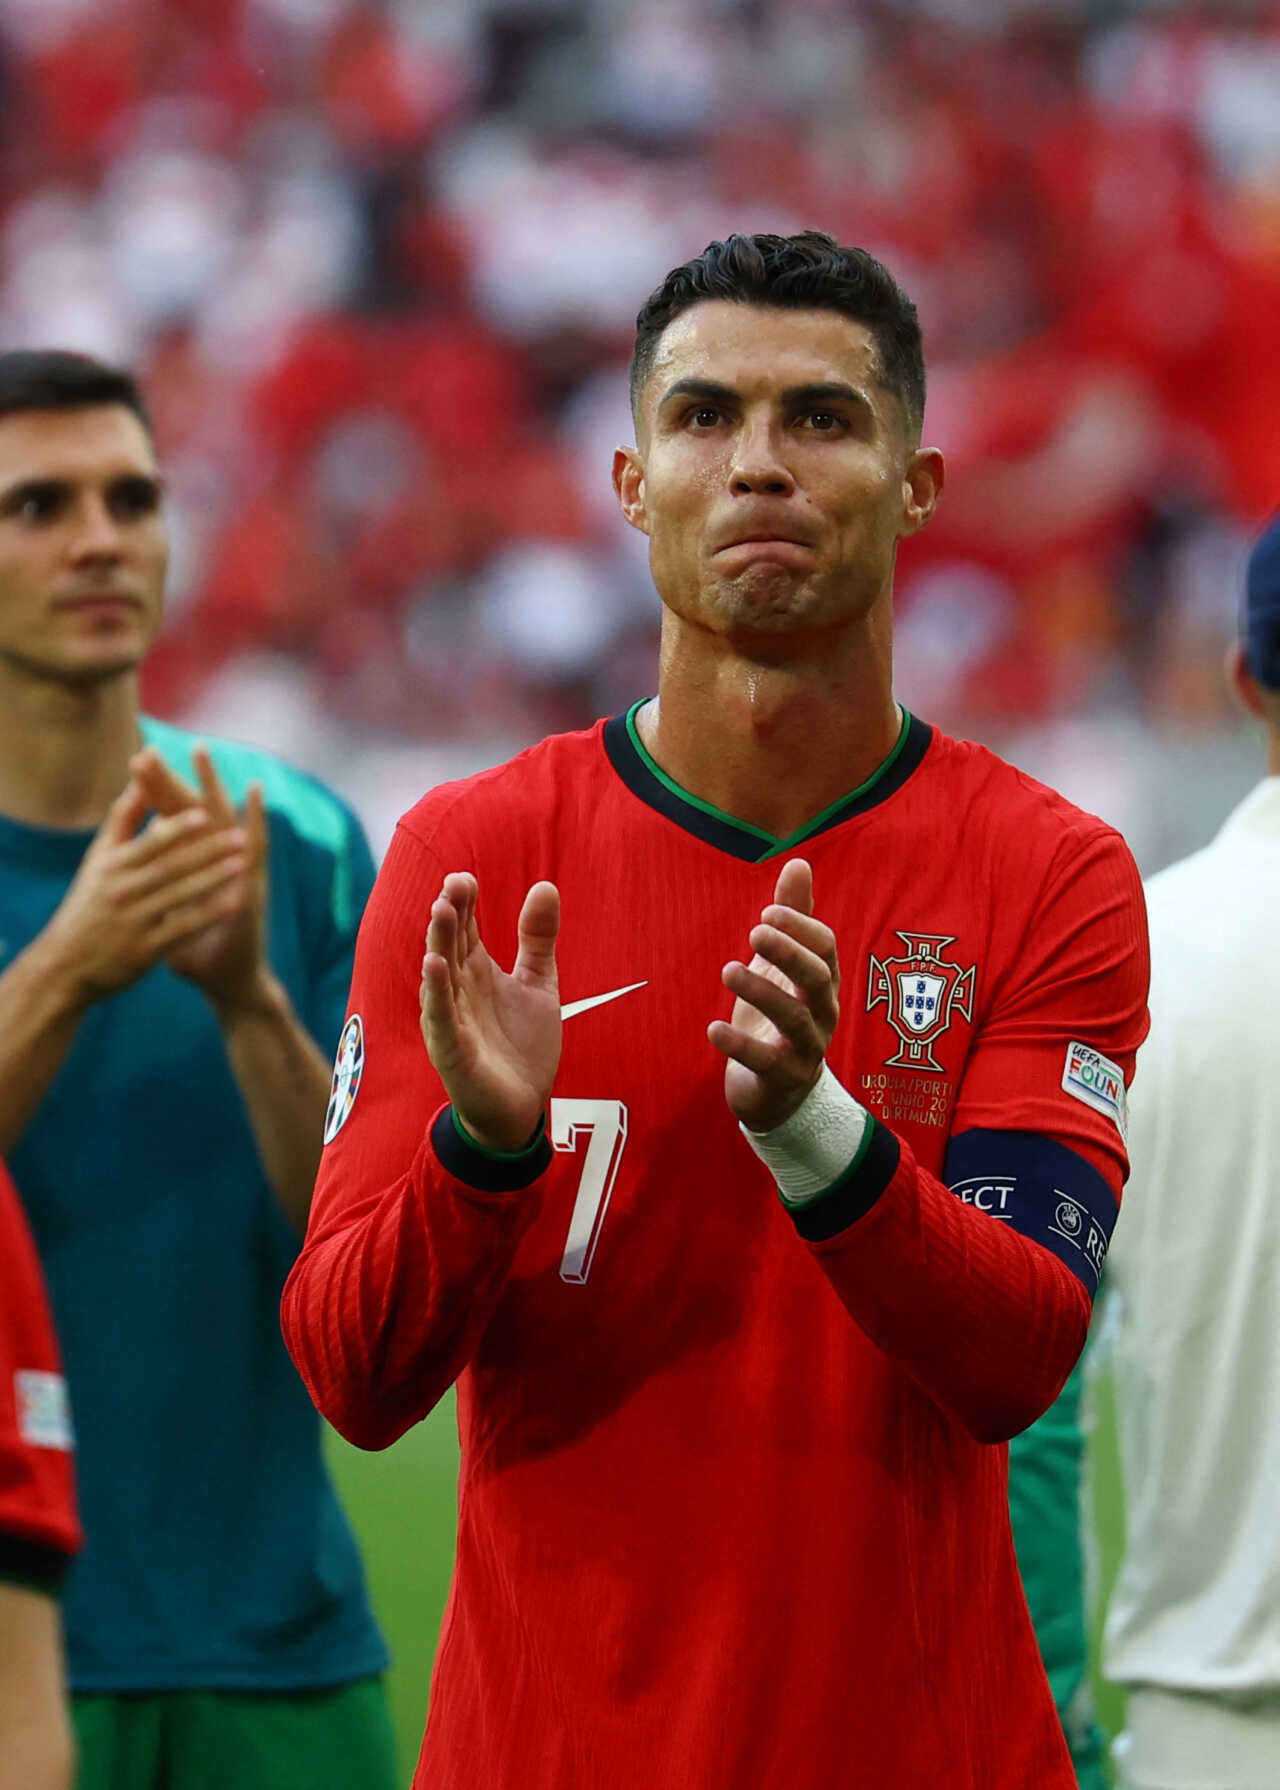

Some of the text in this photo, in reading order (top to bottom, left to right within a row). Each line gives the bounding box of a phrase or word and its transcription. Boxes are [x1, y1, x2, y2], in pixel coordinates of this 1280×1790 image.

[1072, 1045, 1100, 1068] UEFA
[1070, 1057, 1120, 1101] FOUN
[930, 1097, 948, 1112] 20
[551, 1098, 627, 1284] 7
[955, 1186, 1014, 1210] ECT
[1086, 1227, 1106, 1279] RE
